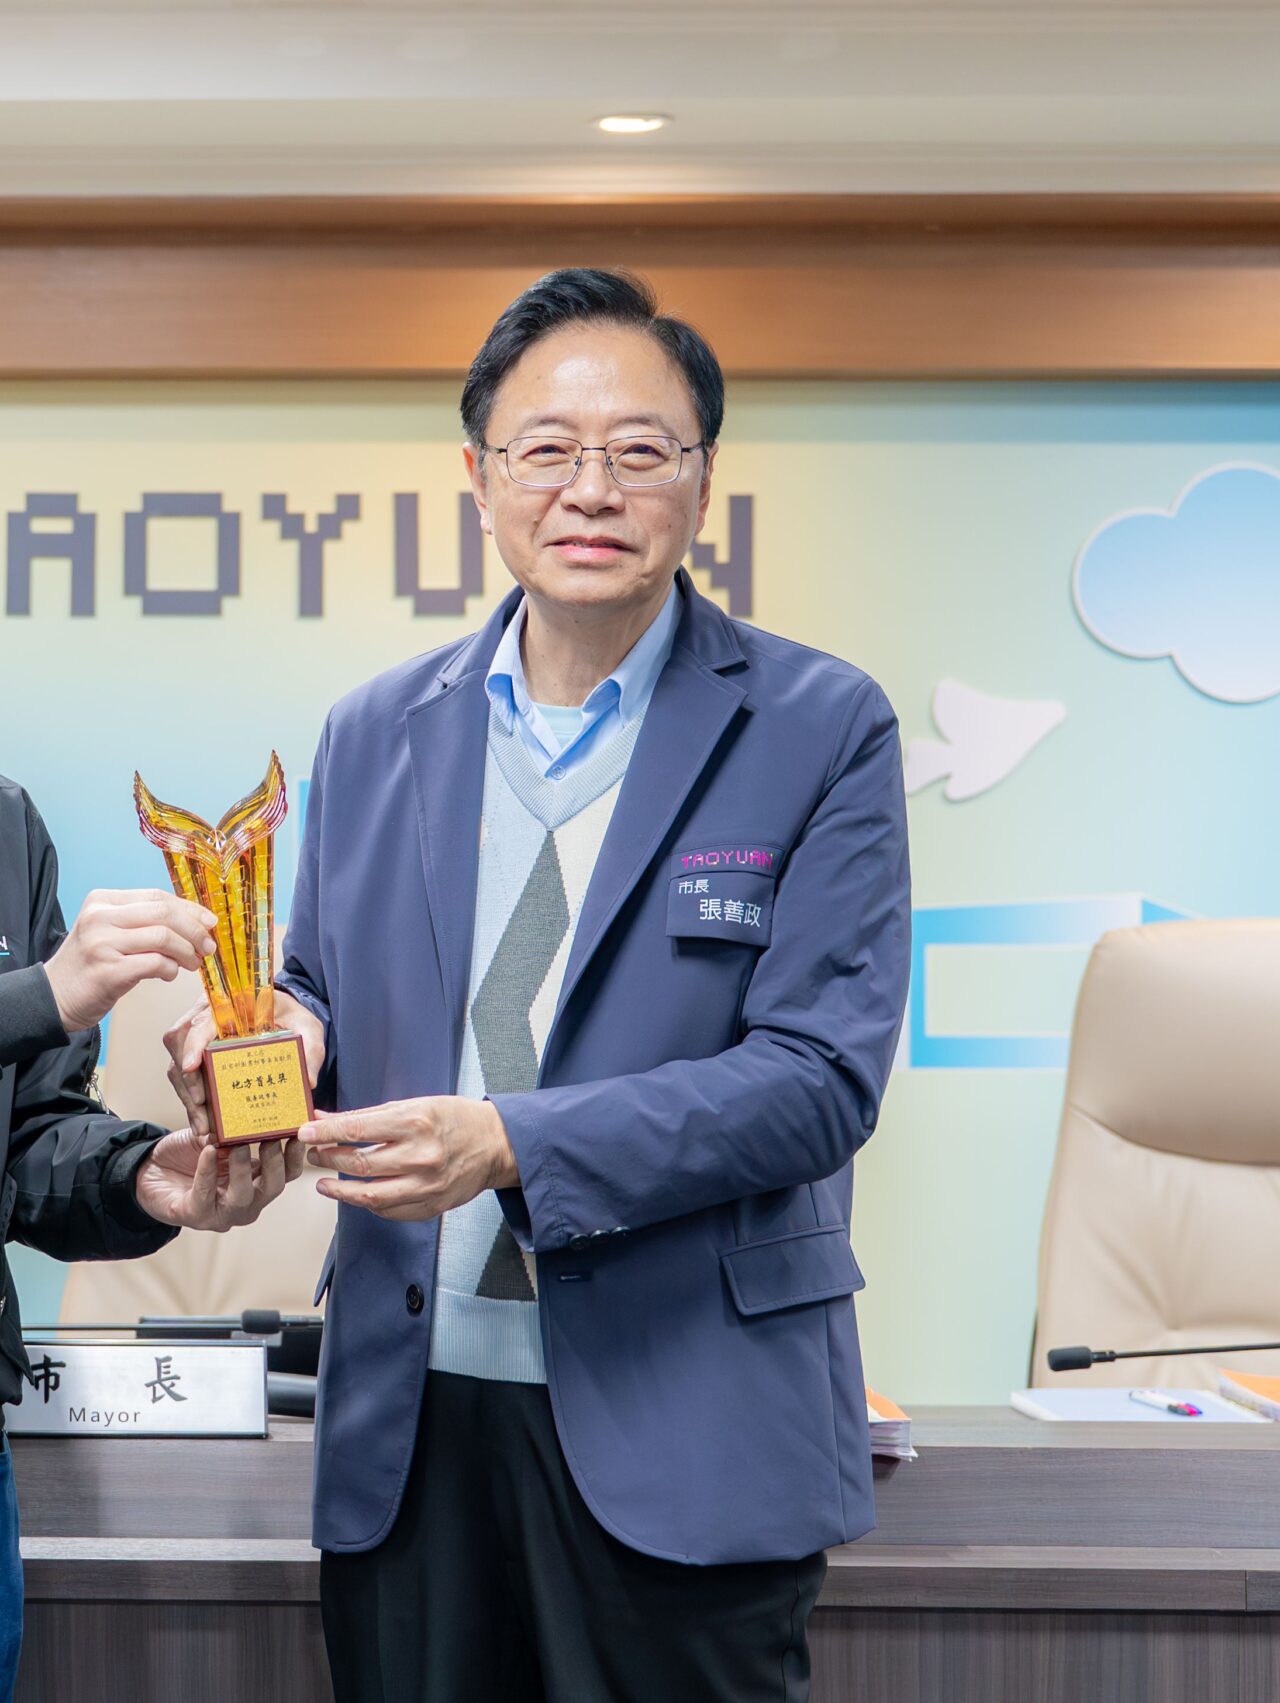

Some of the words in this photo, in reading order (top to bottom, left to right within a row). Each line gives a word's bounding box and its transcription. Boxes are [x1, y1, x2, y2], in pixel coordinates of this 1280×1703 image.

[681, 850, 773, 870] TAOYUAN
[678, 879, 709, 894] 市長
[699, 898, 761, 927] 張善政
[31, 1353, 188, 1404] 市長
[69, 1407, 141, 1427] Mayor
